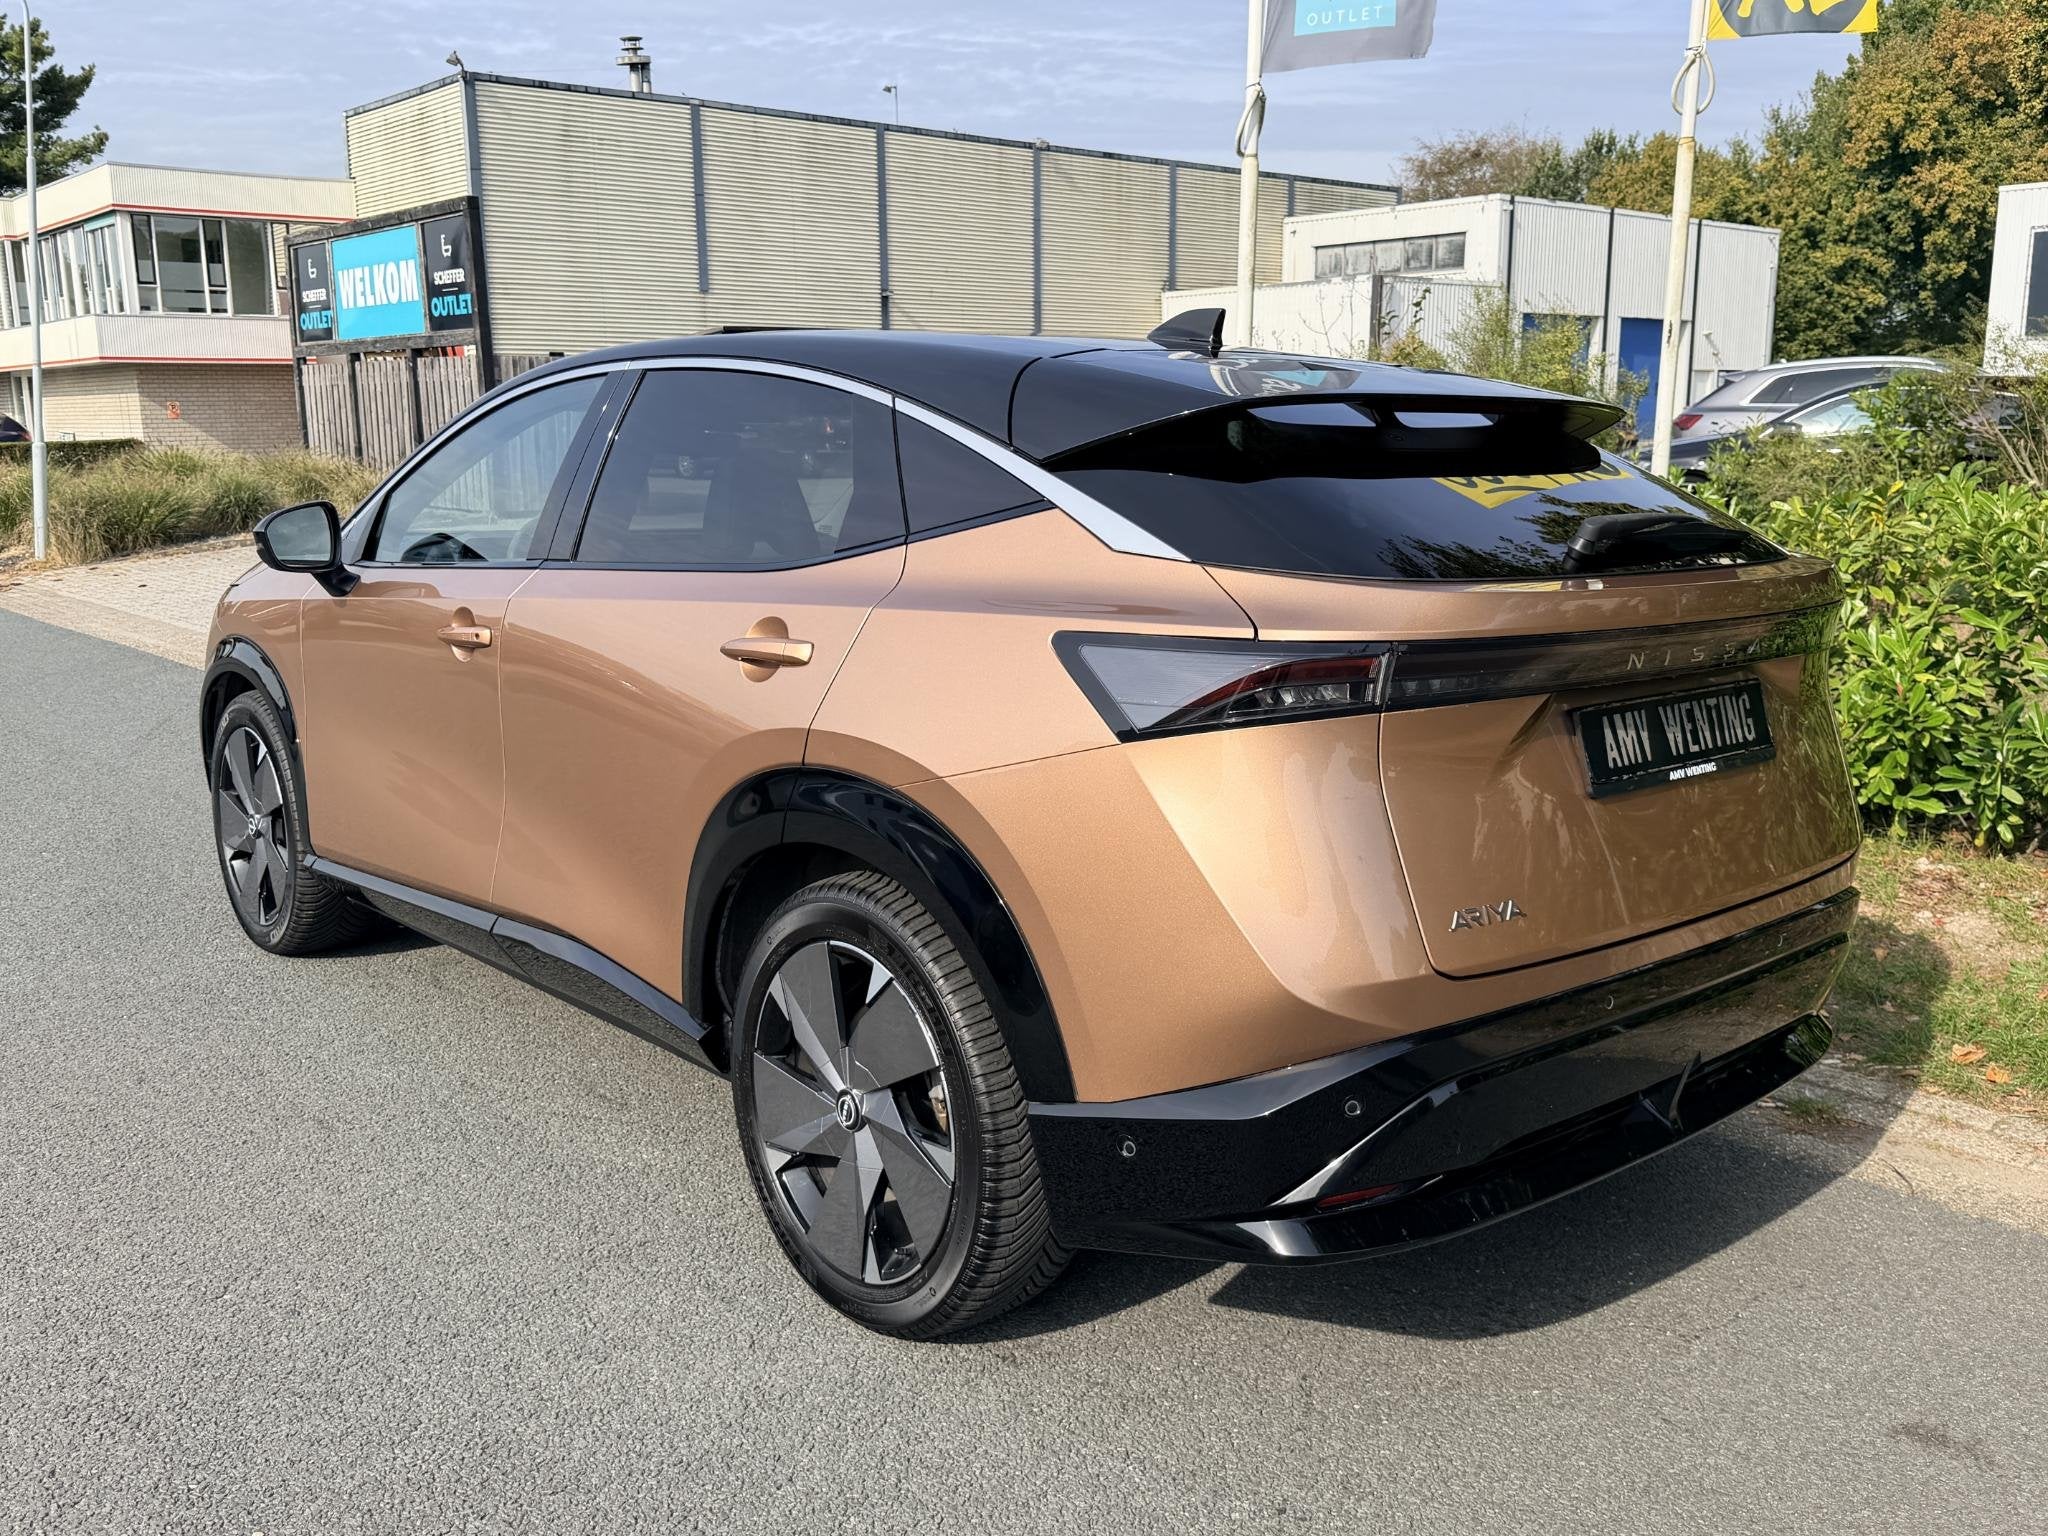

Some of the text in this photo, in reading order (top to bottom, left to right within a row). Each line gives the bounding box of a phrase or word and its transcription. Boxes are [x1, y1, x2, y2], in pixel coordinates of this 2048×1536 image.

[1306, 5, 1383, 26] OUTLET
[338, 259, 419, 310] WELKOM
[433, 268, 466, 285] SCHEFFER
[431, 293, 473, 317] OUTLET
[300, 310, 333, 330] OUTLET
[1627, 638, 1762, 670] NISSA
[1602, 691, 1756, 769] AMV WENTING
[1669, 761, 1717, 780] AMV WENTING
[1448, 899, 1527, 933] ARIYA
